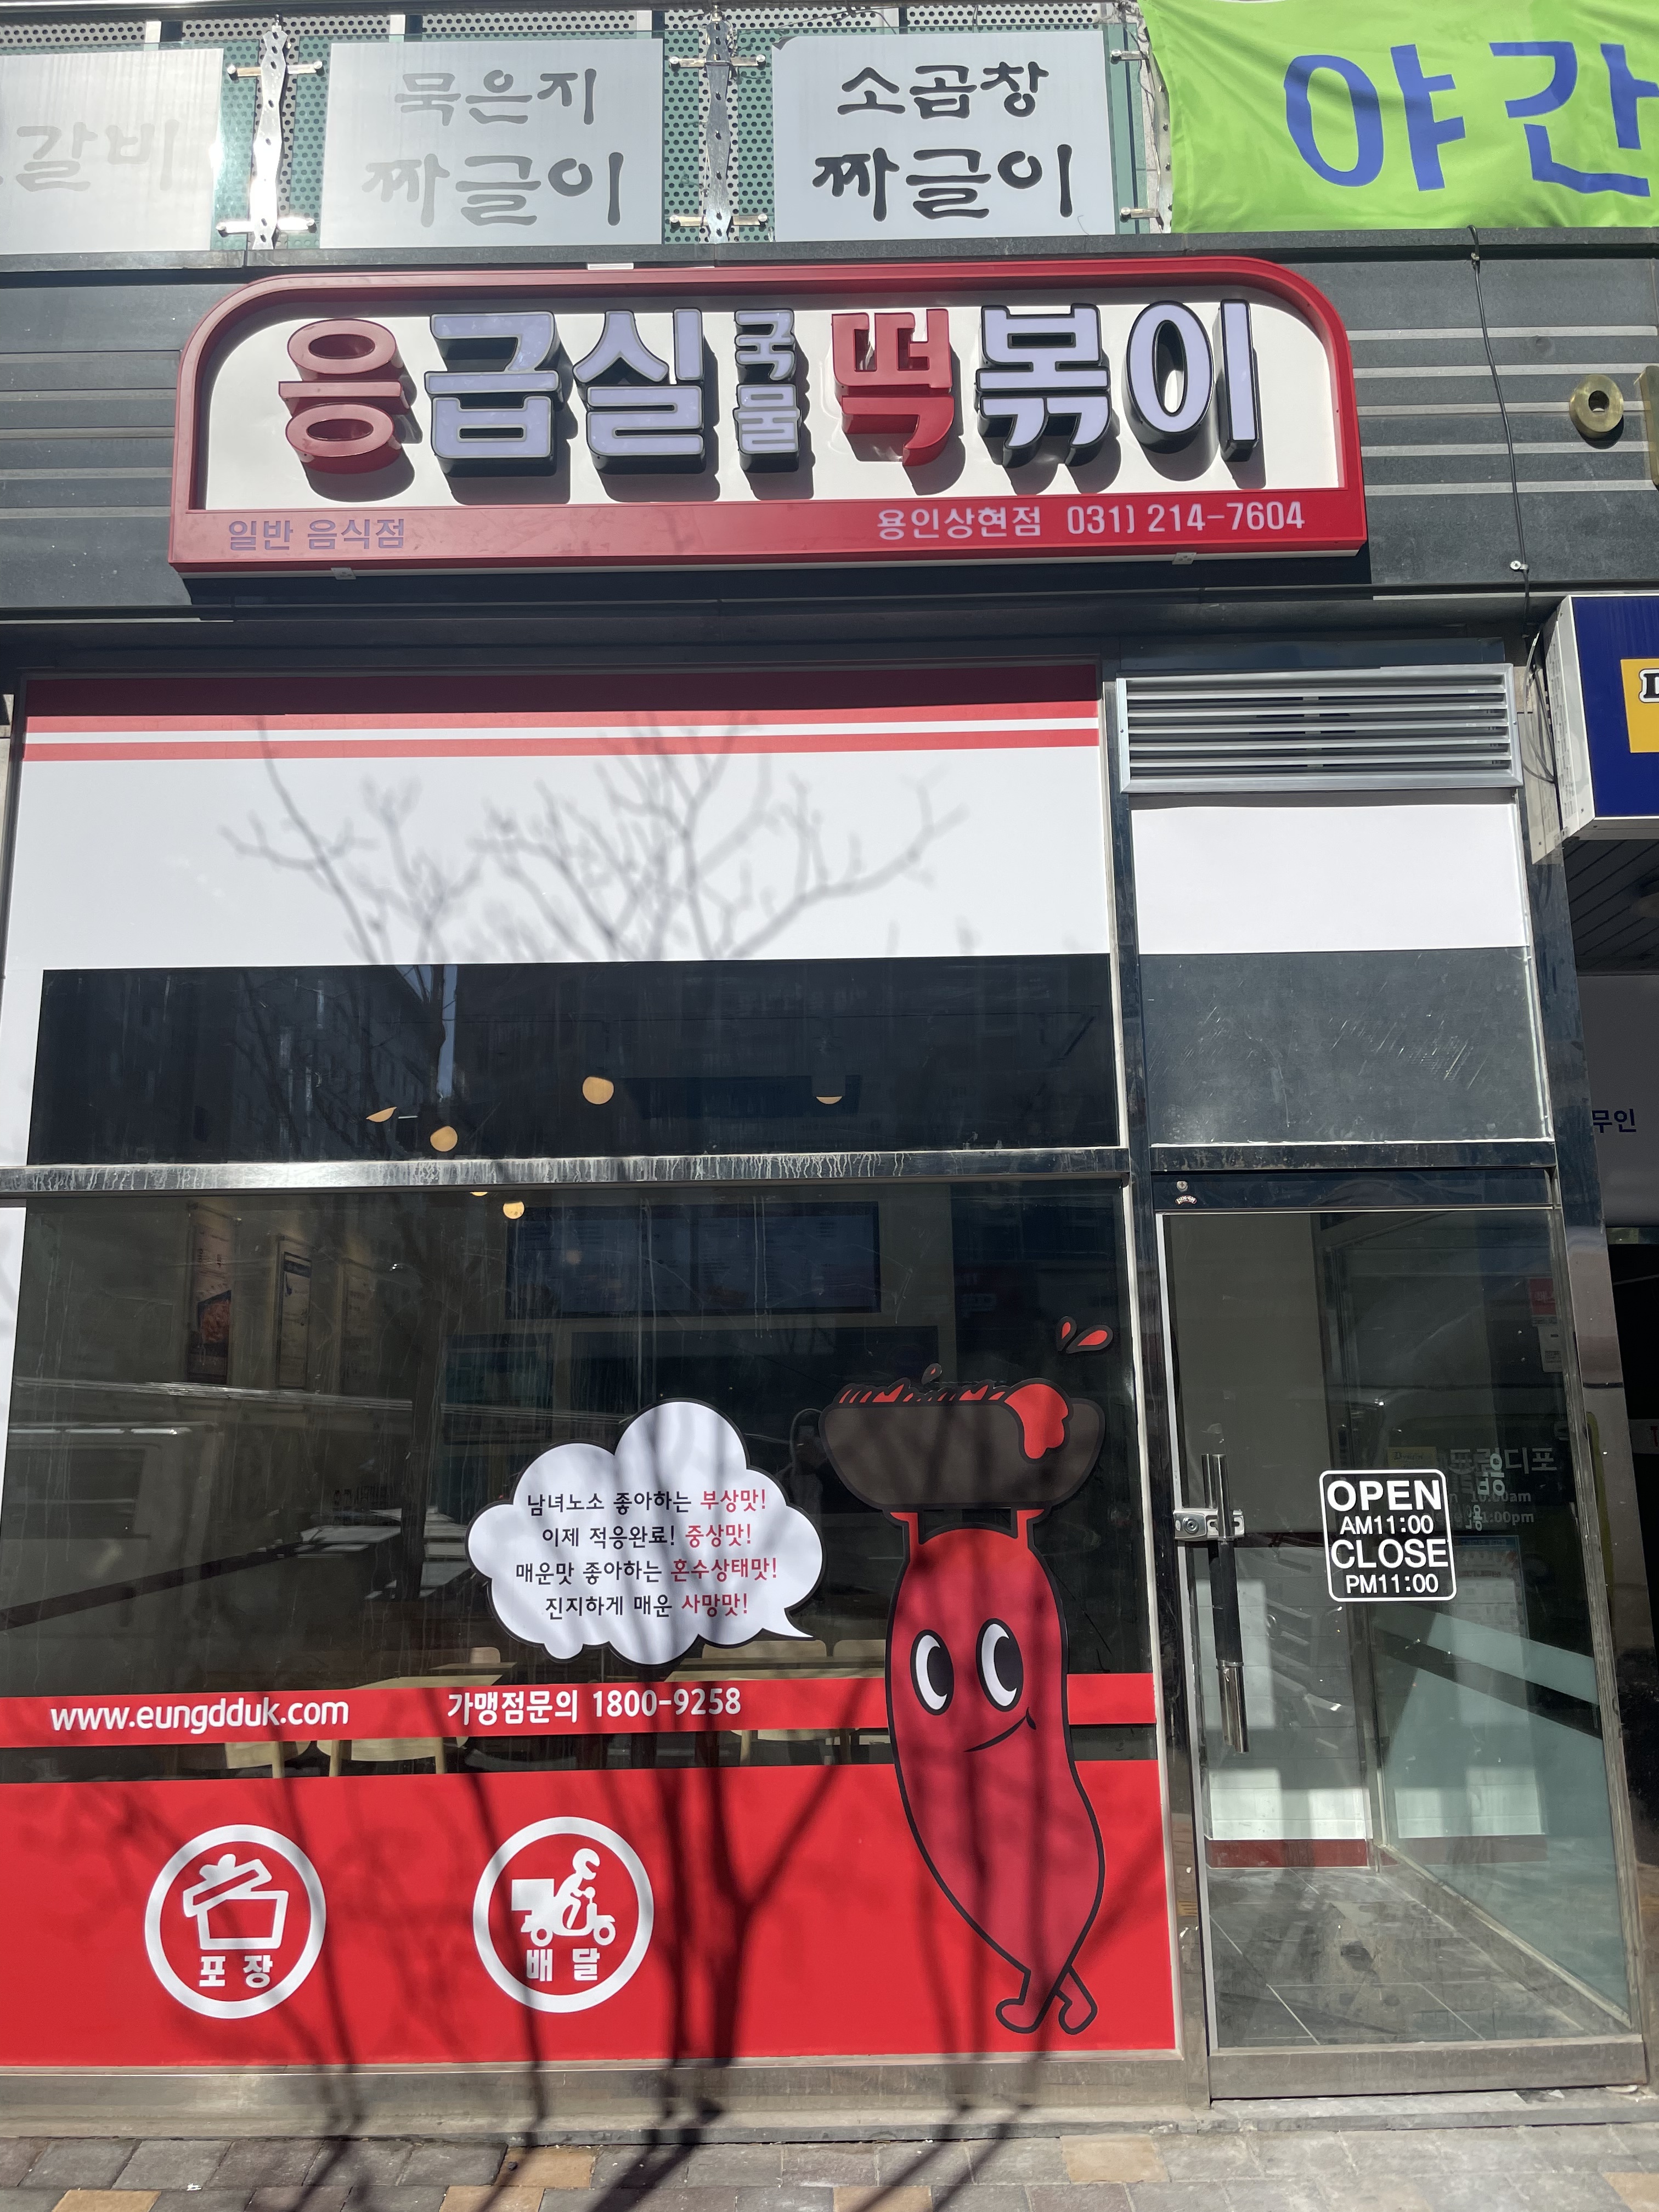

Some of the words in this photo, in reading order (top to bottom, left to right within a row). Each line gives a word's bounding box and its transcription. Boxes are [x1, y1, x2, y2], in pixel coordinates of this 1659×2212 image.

[394, 69, 596, 126] 묵은지
[837, 61, 1049, 120] 소곱창
[1284, 41, 1659, 198] 야간
[0, 119, 179, 192] 갈비
[362, 152, 624, 227] 짜글이
[812, 144, 1073, 222] 짜글이
[278, 308, 706, 471] 응급실
[734, 308, 802, 467] 국물
[831, 299, 1259, 465] 떡볶이
[228, 519, 294, 551] 일반
[307, 518, 405, 549] 음식점
[878, 505, 1041, 540] 용인상현점
[1148, 500, 1305, 533] 214-7604
[527, 1492, 605, 1516] 남녀노소
[613, 1490, 692, 1515] 좋아하는
[699, 1488, 766, 1513] 부상맛!
[1327, 1479, 1442, 1512] OPEN
[542, 1527, 580, 1547] 이제
[589, 1525, 675, 1550] 적응완료!
[685, 1523, 752, 1548] 중상맛!
[1339, 1515, 1434, 1535] AM11:00
[516, 1561, 574, 1585] 매운맛
[582, 1560, 663, 1585] 좋아하는
[670, 1558, 777, 1583] 혼수상태맛!
[1330, 1538, 1449, 1569] CLOSE
[1346, 1573, 1439, 1594] PM11:00
[545, 1595, 624, 1620] 진지하게
[634, 1594, 672, 1618] 매운
[681, 1593, 748, 1617] 사망맛!
[50, 1697, 349, 1735] www.eungdduk.com
[447, 1689, 578, 1726] 가맹점문의
[592, 1688, 741, 1718] 1800-9258
